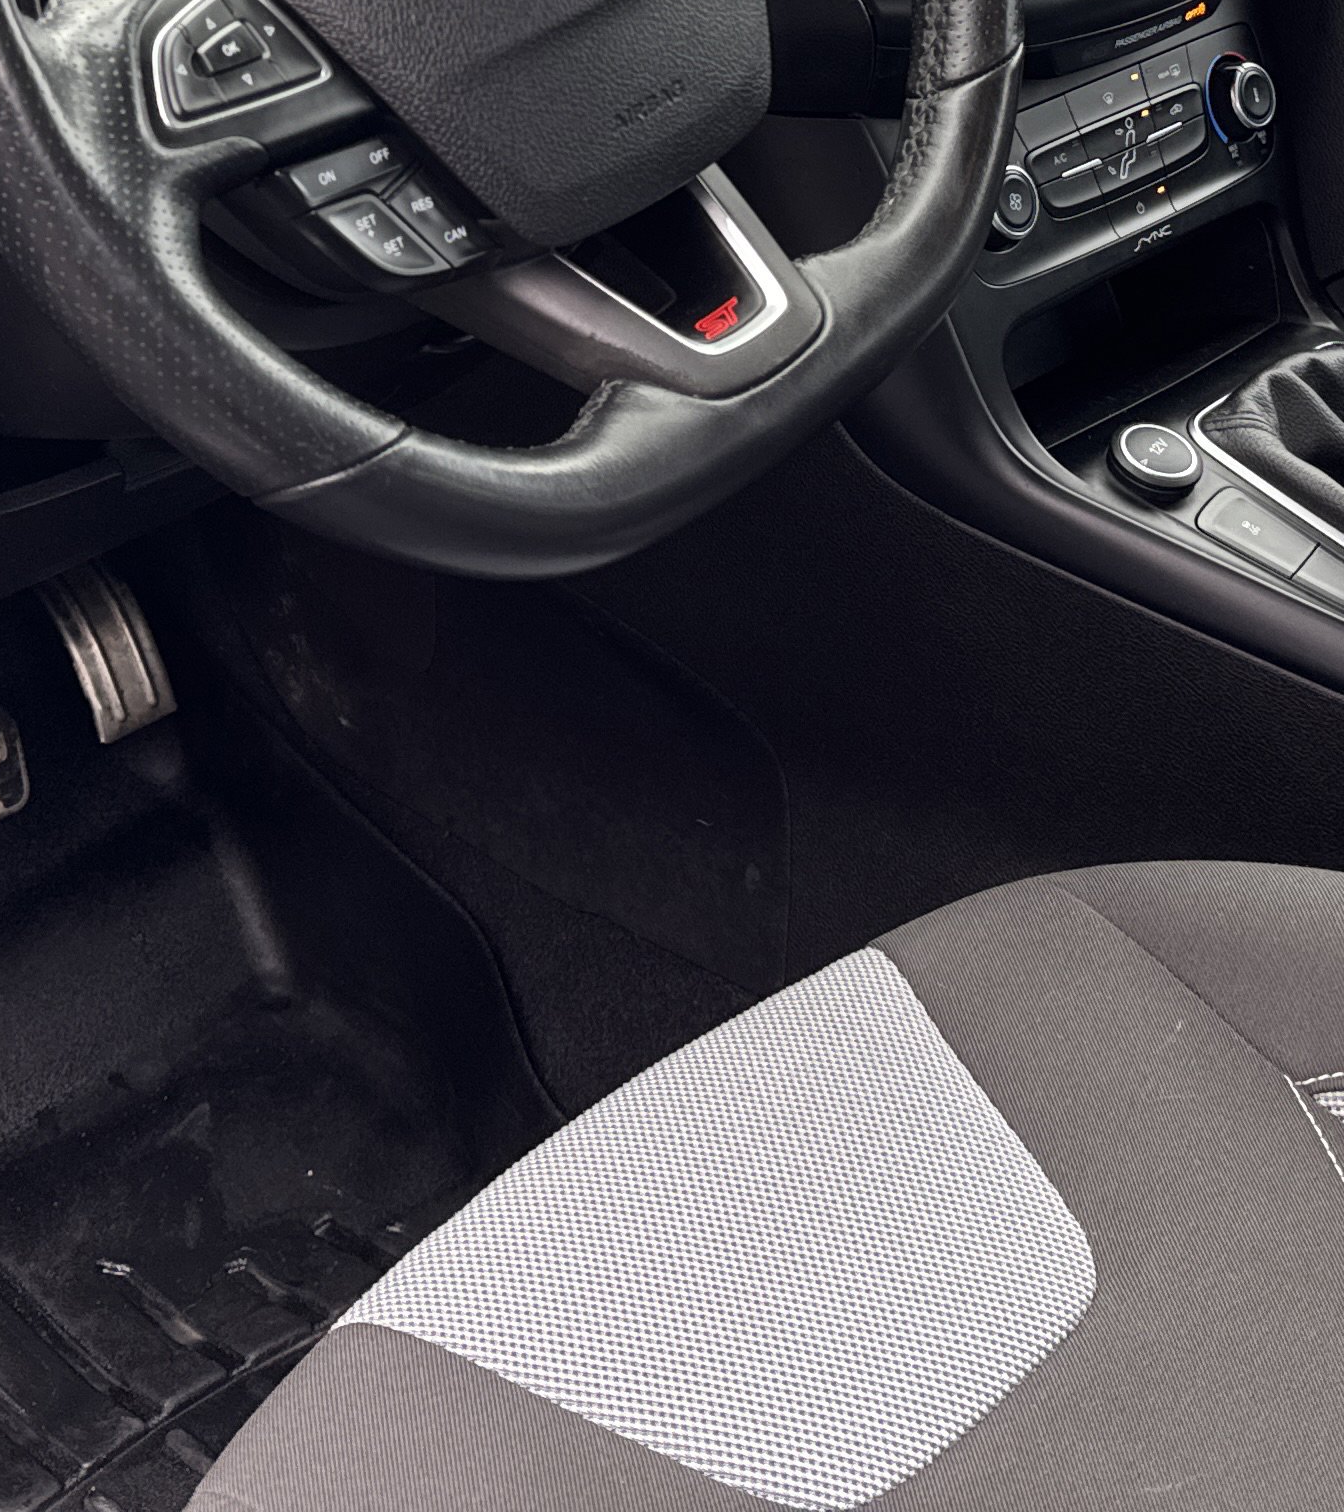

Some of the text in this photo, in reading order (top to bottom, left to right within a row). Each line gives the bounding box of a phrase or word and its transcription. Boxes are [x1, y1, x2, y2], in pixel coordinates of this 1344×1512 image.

[221, 41, 241, 57] OK
[369, 147, 391, 165] OFF
[318, 169, 337, 185] ON
[410, 196, 434, 214] RES
[356, 213, 377, 232] SET
[444, 226, 468, 244] CAN
[1134, 224, 1172, 252] SYNC
[383, 235, 405, 254] SET
[693, 296, 739, 340] ST
[1148, 437, 1168, 455] 12V
